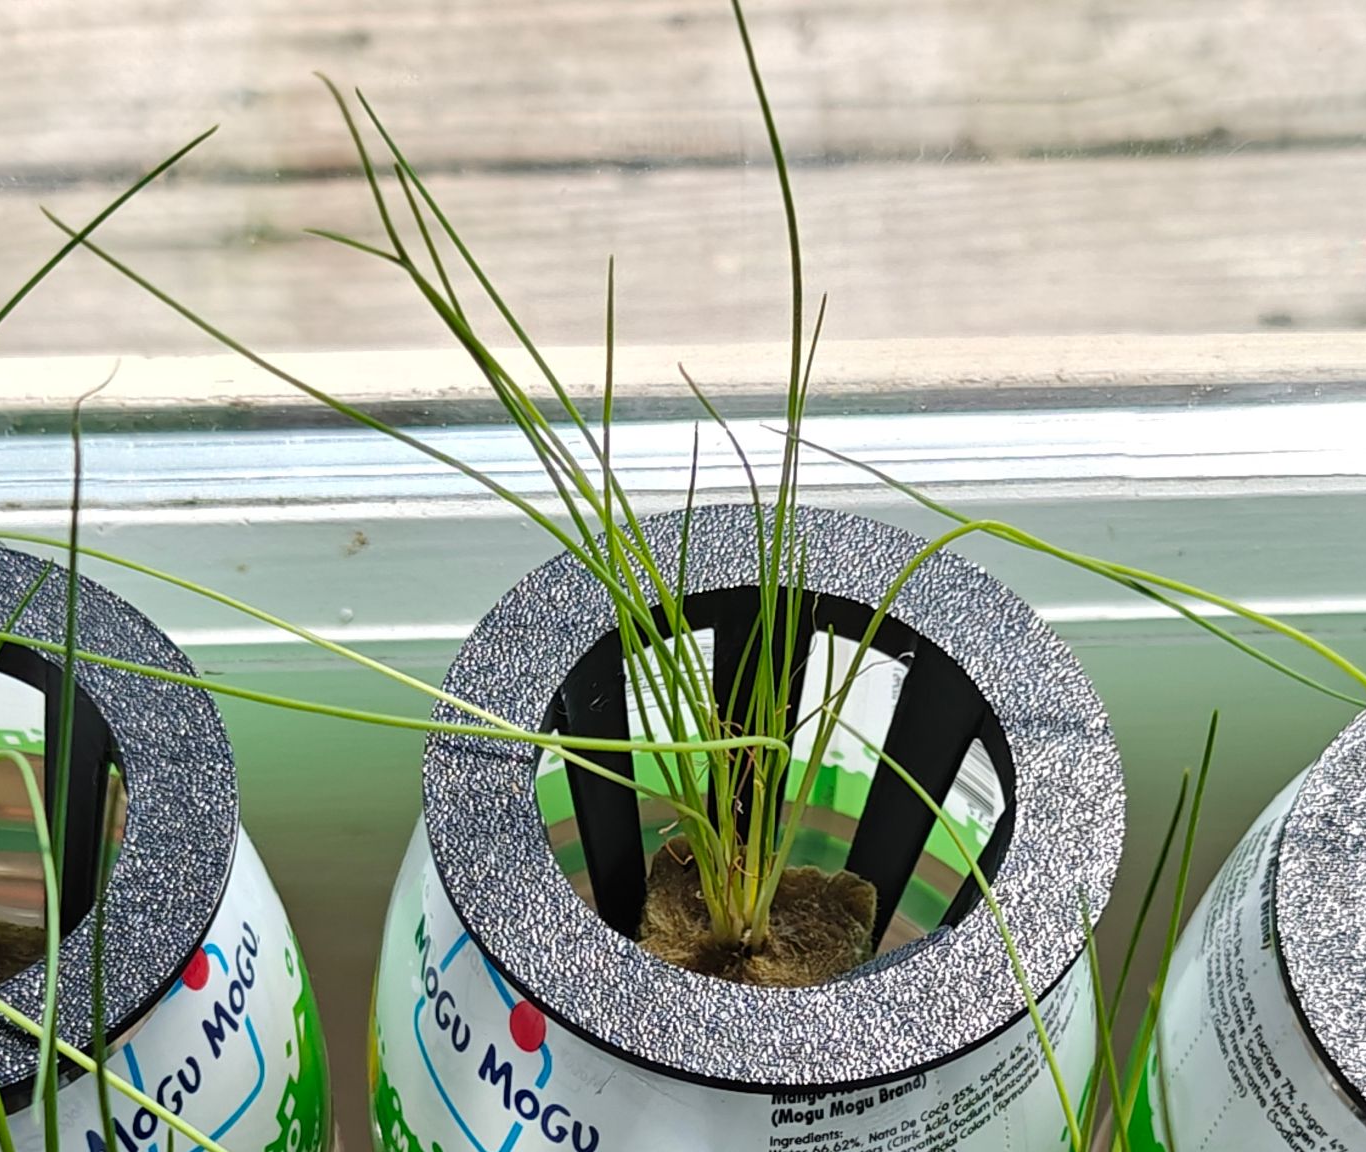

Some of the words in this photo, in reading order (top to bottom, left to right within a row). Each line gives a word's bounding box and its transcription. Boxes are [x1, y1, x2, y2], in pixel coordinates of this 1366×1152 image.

[771, 1105, 826, 1128] (Mogu
[829, 1096, 875, 1119] Mogu
[883, 1072, 927, 1104] Brand)
[887, 1129, 921, 1151] (Citric
[954, 1086, 994, 1118] Calcium
[948, 1102, 992, 1139] (Sodium
[769, 1129, 844, 1148] Ingredients:
[868, 1127, 898, 1144] Nata
[901, 1119, 917, 1136] De
[920, 1101, 950, 1122] Coco
